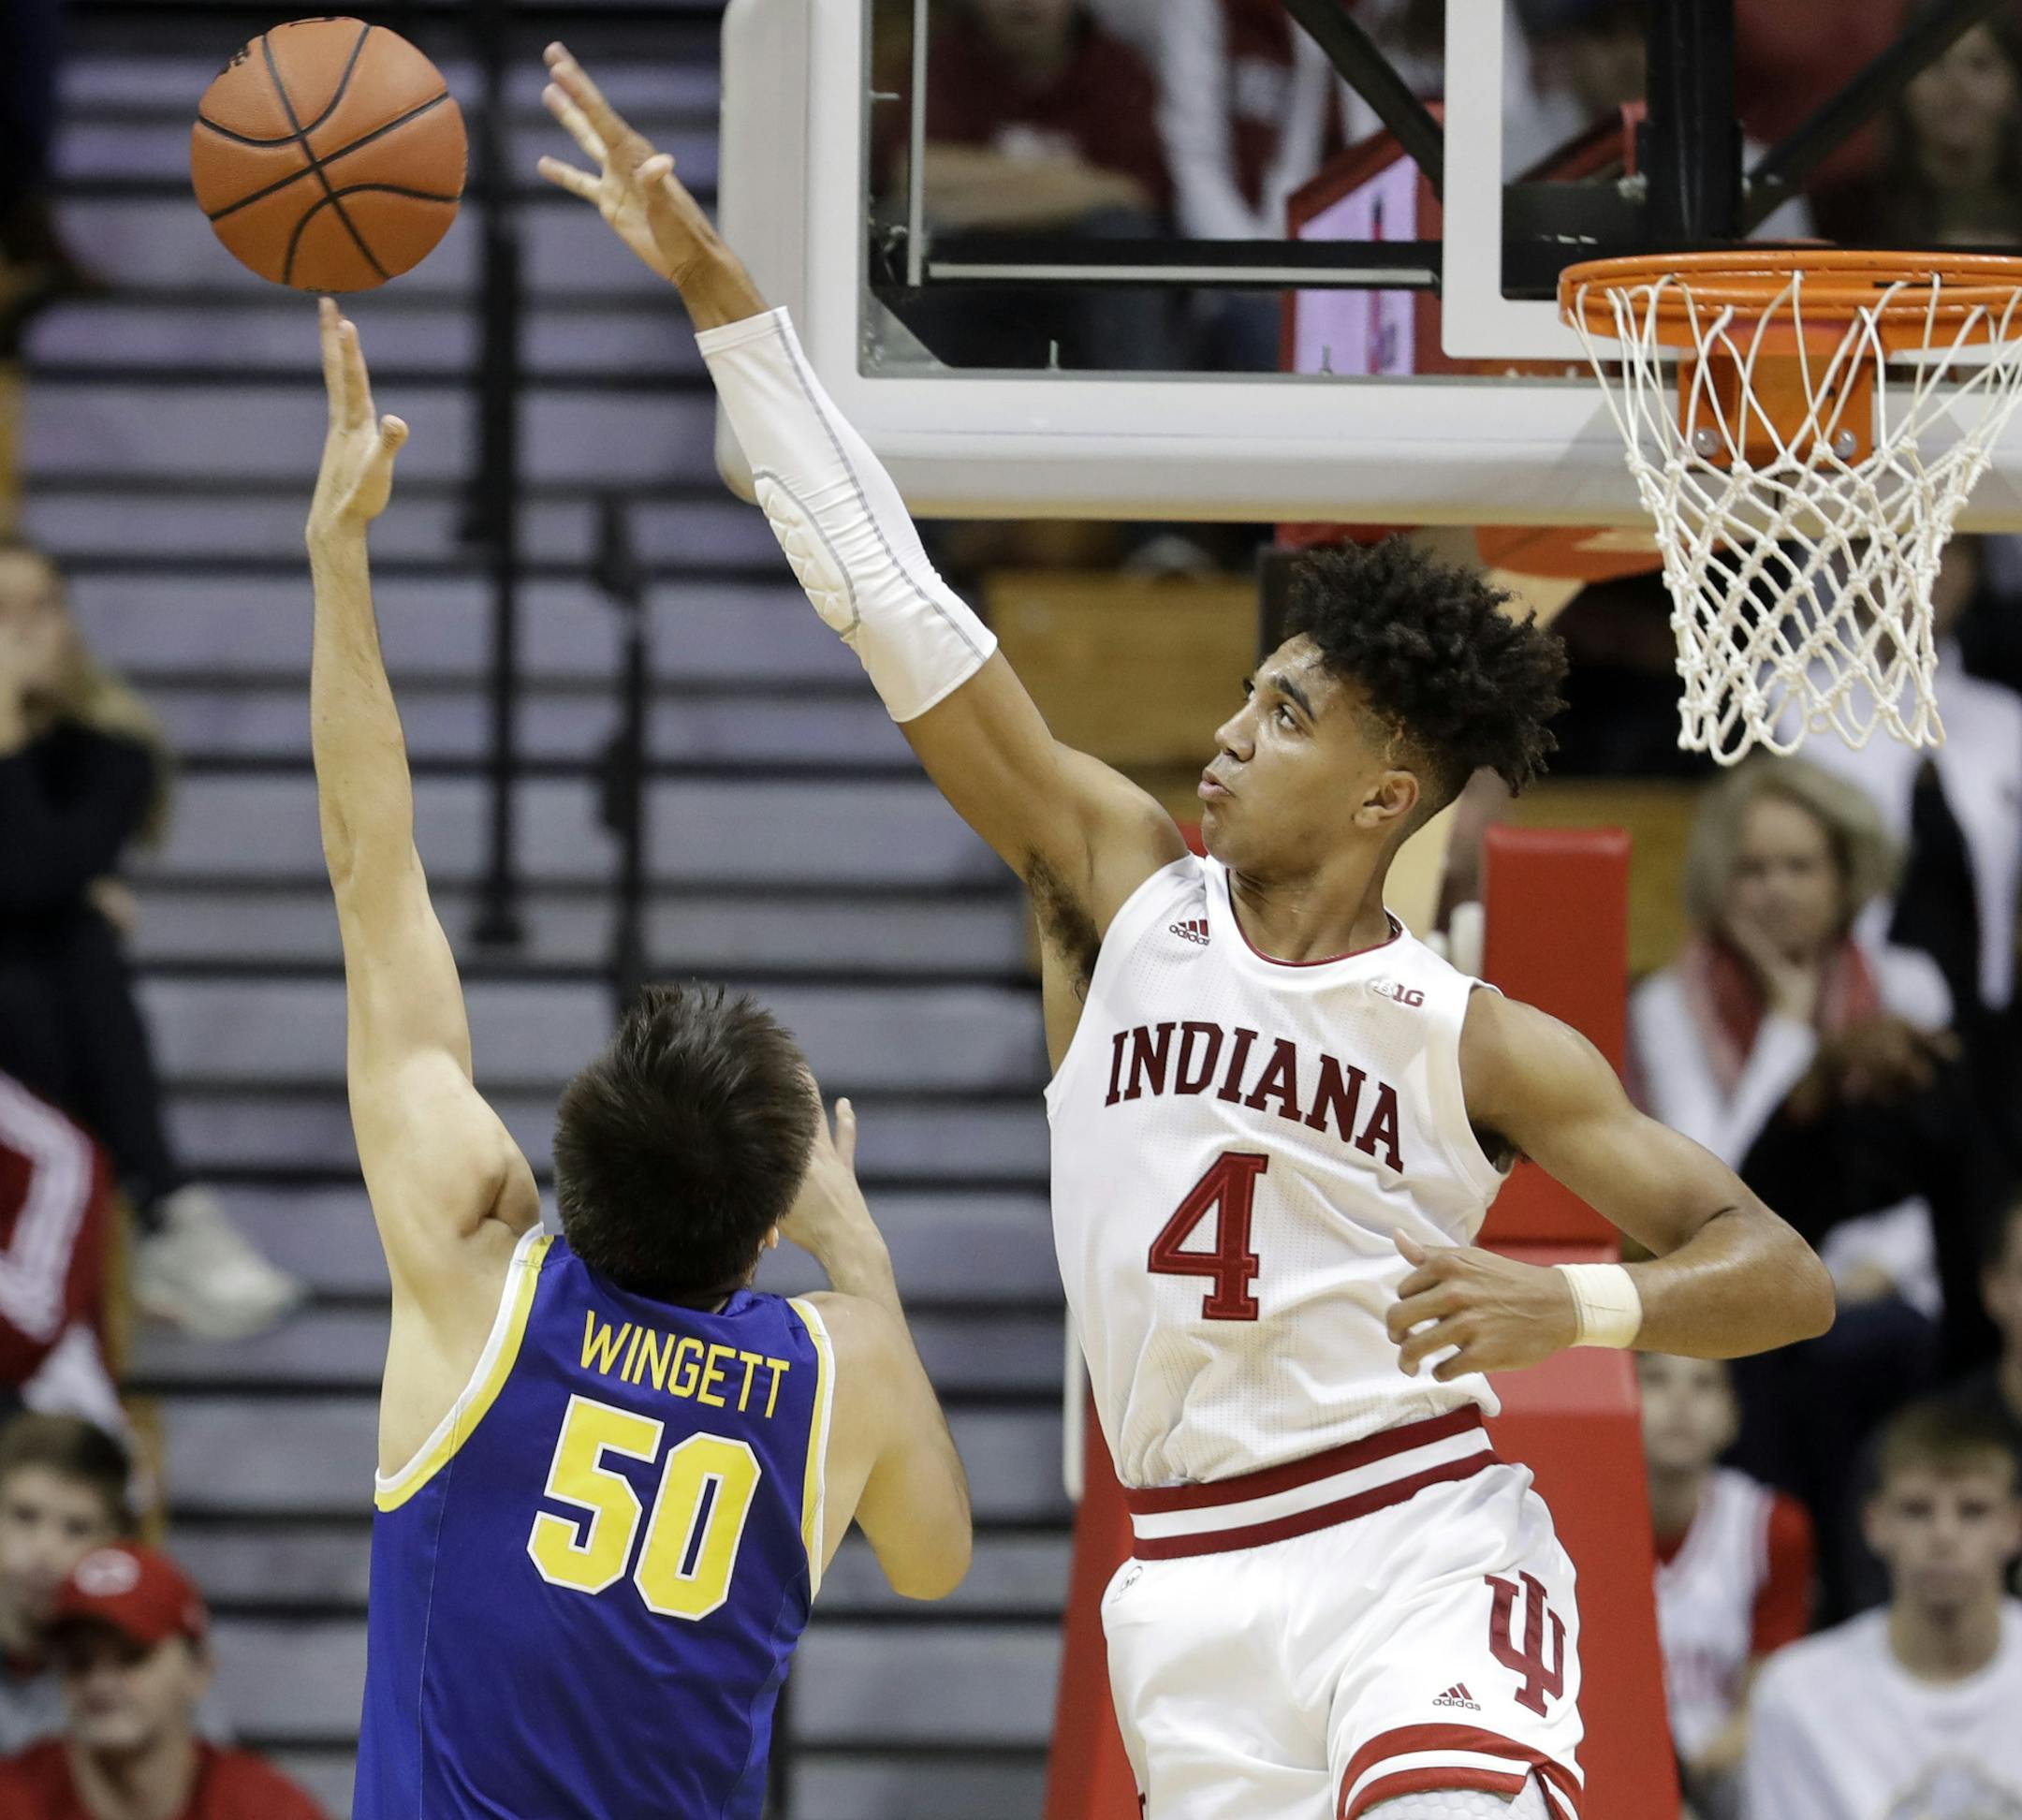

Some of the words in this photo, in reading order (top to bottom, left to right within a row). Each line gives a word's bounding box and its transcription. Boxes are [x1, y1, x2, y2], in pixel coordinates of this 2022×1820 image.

[1105, 1021, 1403, 1174] INDIANA
[1148, 1151, 1269, 1321] 4
[579, 1310, 791, 1419] WINGETT
[527, 1393, 762, 1622] 50
[1432, 1696, 1481, 1711] adidas
